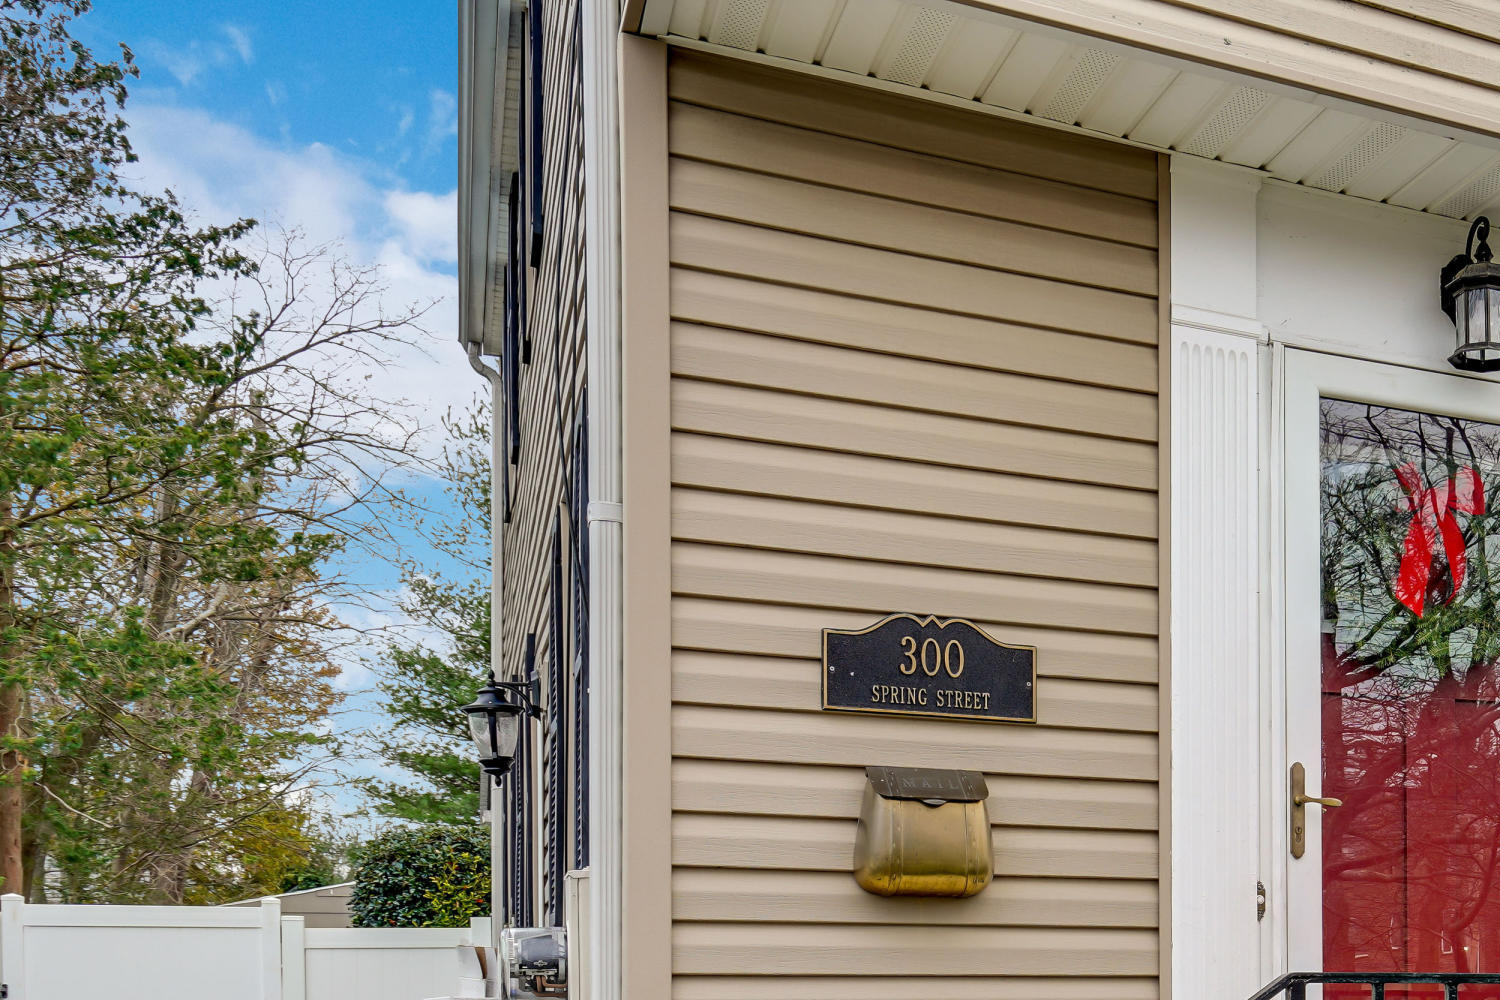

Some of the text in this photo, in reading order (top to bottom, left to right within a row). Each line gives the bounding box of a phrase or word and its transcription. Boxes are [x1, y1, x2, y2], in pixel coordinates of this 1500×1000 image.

[900, 636, 965, 678] 300
[871, 684, 991, 710] SPRING STREET
